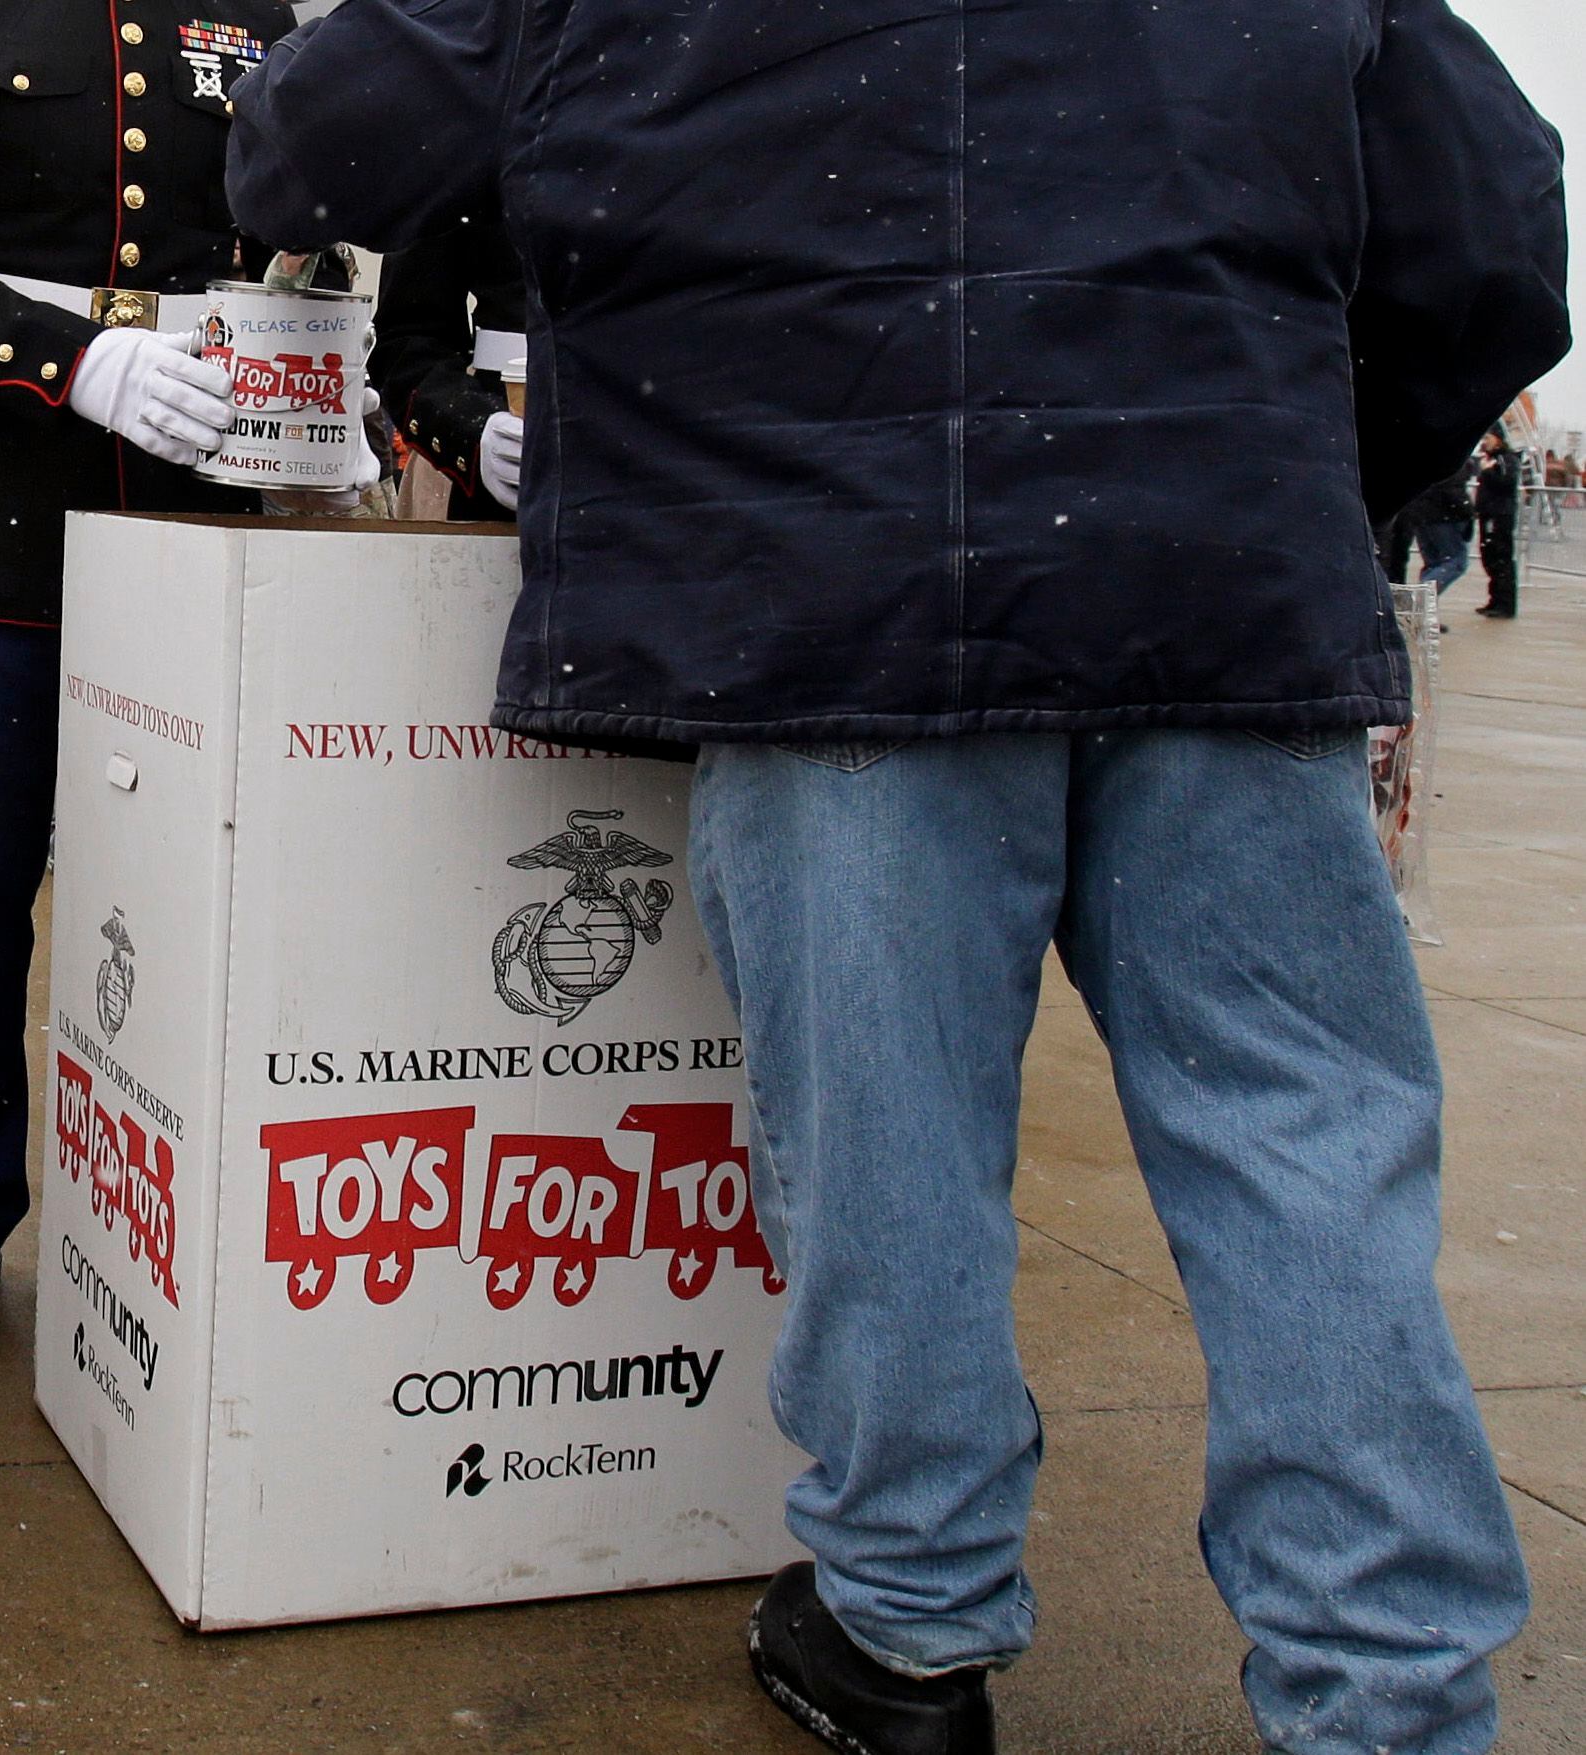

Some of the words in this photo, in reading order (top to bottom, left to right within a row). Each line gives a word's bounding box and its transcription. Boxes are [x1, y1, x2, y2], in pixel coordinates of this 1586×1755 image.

[239, 319, 298, 333] PLEASE
[236, 363, 275, 392] FOR
[288, 372, 339, 400] TOTS
[285, 426, 303, 438] FOR
[306, 424, 346, 443] TOTS
[218, 454, 282, 472] MAJESTIC
[285, 461, 319, 475] STEEL
[67, 674, 85, 708] NEW,
[86, 682, 140, 726] UNWRAPPED
[142, 704, 169, 738] TOYS
[170, 715, 204, 750] ONLY
[284, 723, 393, 766] NEW,
[72, 1023, 104, 1071] MARINE
[105, 1055, 135, 1098] CORPS
[135, 1084, 184, 1142] RESERVE
[264, 1051, 344, 1085] U.S.
[356, 1045, 533, 1083] MARINE
[542, 1039, 680, 1077] CORPS
[689, 1036, 745, 1069] RE
[60, 1077, 87, 1146] TOYS
[94, 1117, 120, 1197] FOR
[128, 1165, 169, 1260] TOTS
[279, 1136, 450, 1241] TOYS
[488, 1155, 618, 1245] FOR
[660, 1159, 748, 1232] TO
[62, 1234, 158, 1390] community
[89, 1345, 134, 1431] RockTenn
[392, 1344, 724, 1417] community
[502, 1444, 656, 1483] RockTenn
